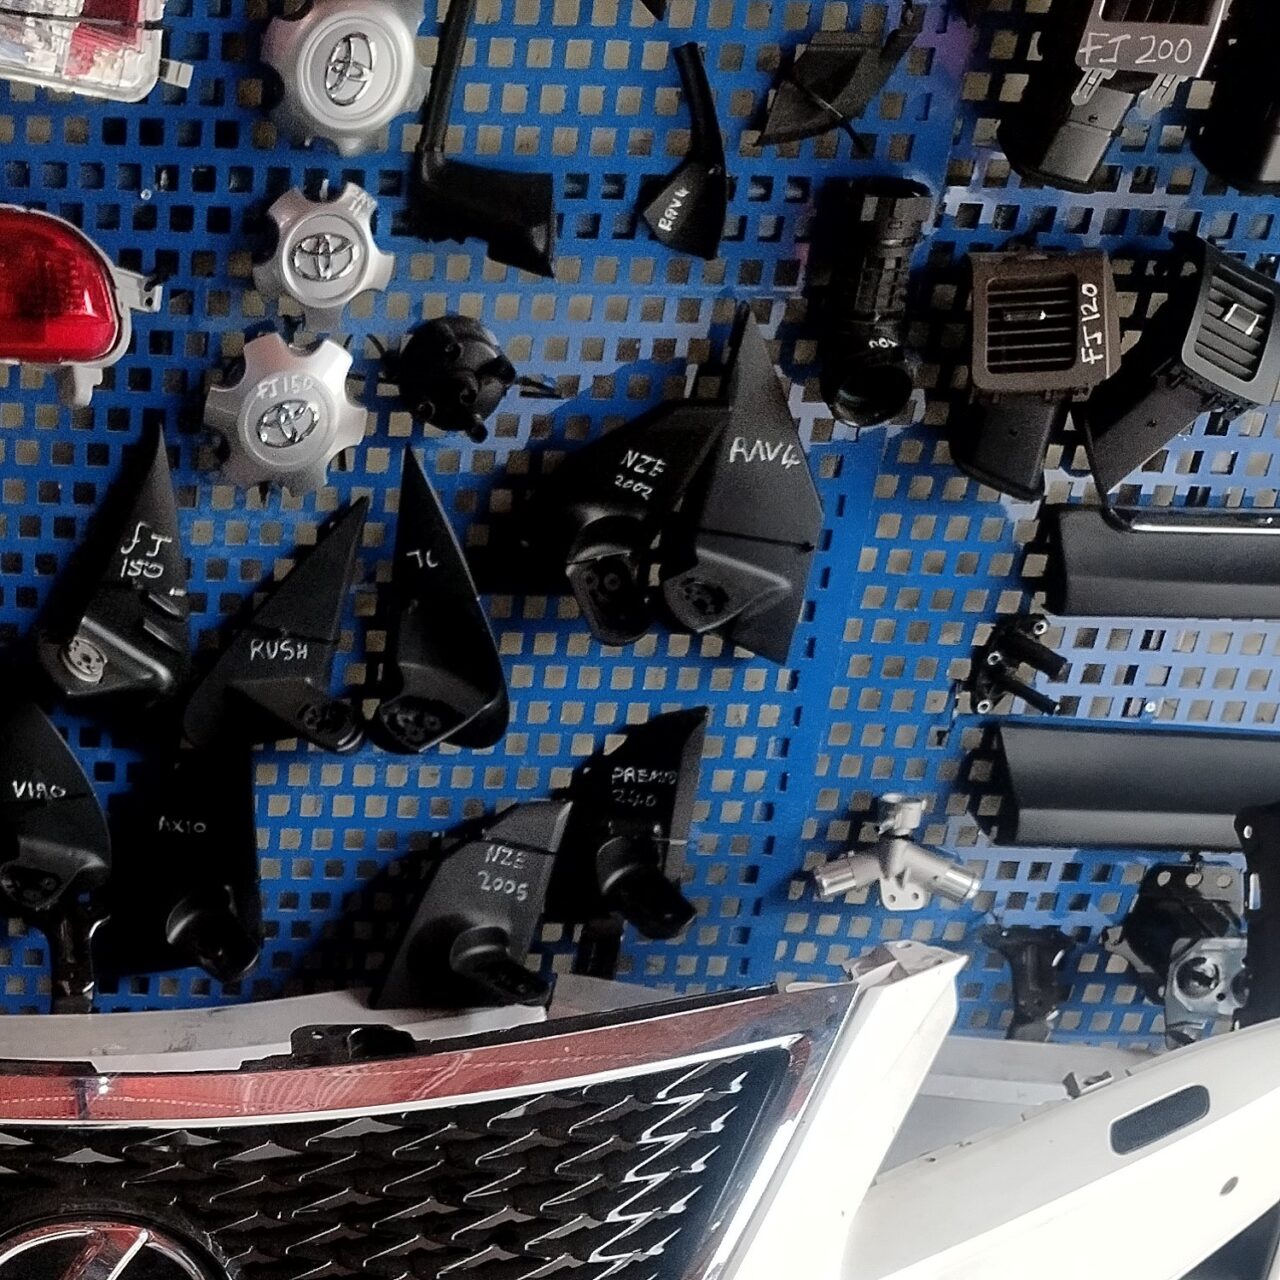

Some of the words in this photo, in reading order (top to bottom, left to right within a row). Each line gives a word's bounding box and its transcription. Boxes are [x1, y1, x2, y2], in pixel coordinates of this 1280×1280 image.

[1080, 32, 1131, 65] FJ
[1135, 35, 1192, 63] 200
[1081, 283, 1100, 321] 120
[1081, 326, 1103, 365] FJ
[620, 450, 666, 477] NZE
[729, 436, 801, 469] RAV4
[614, 475, 653, 500] 2002
[250, 638, 308, 661] RUSH
[485, 845, 525, 869] NZE
[478, 870, 528, 901] 2005
